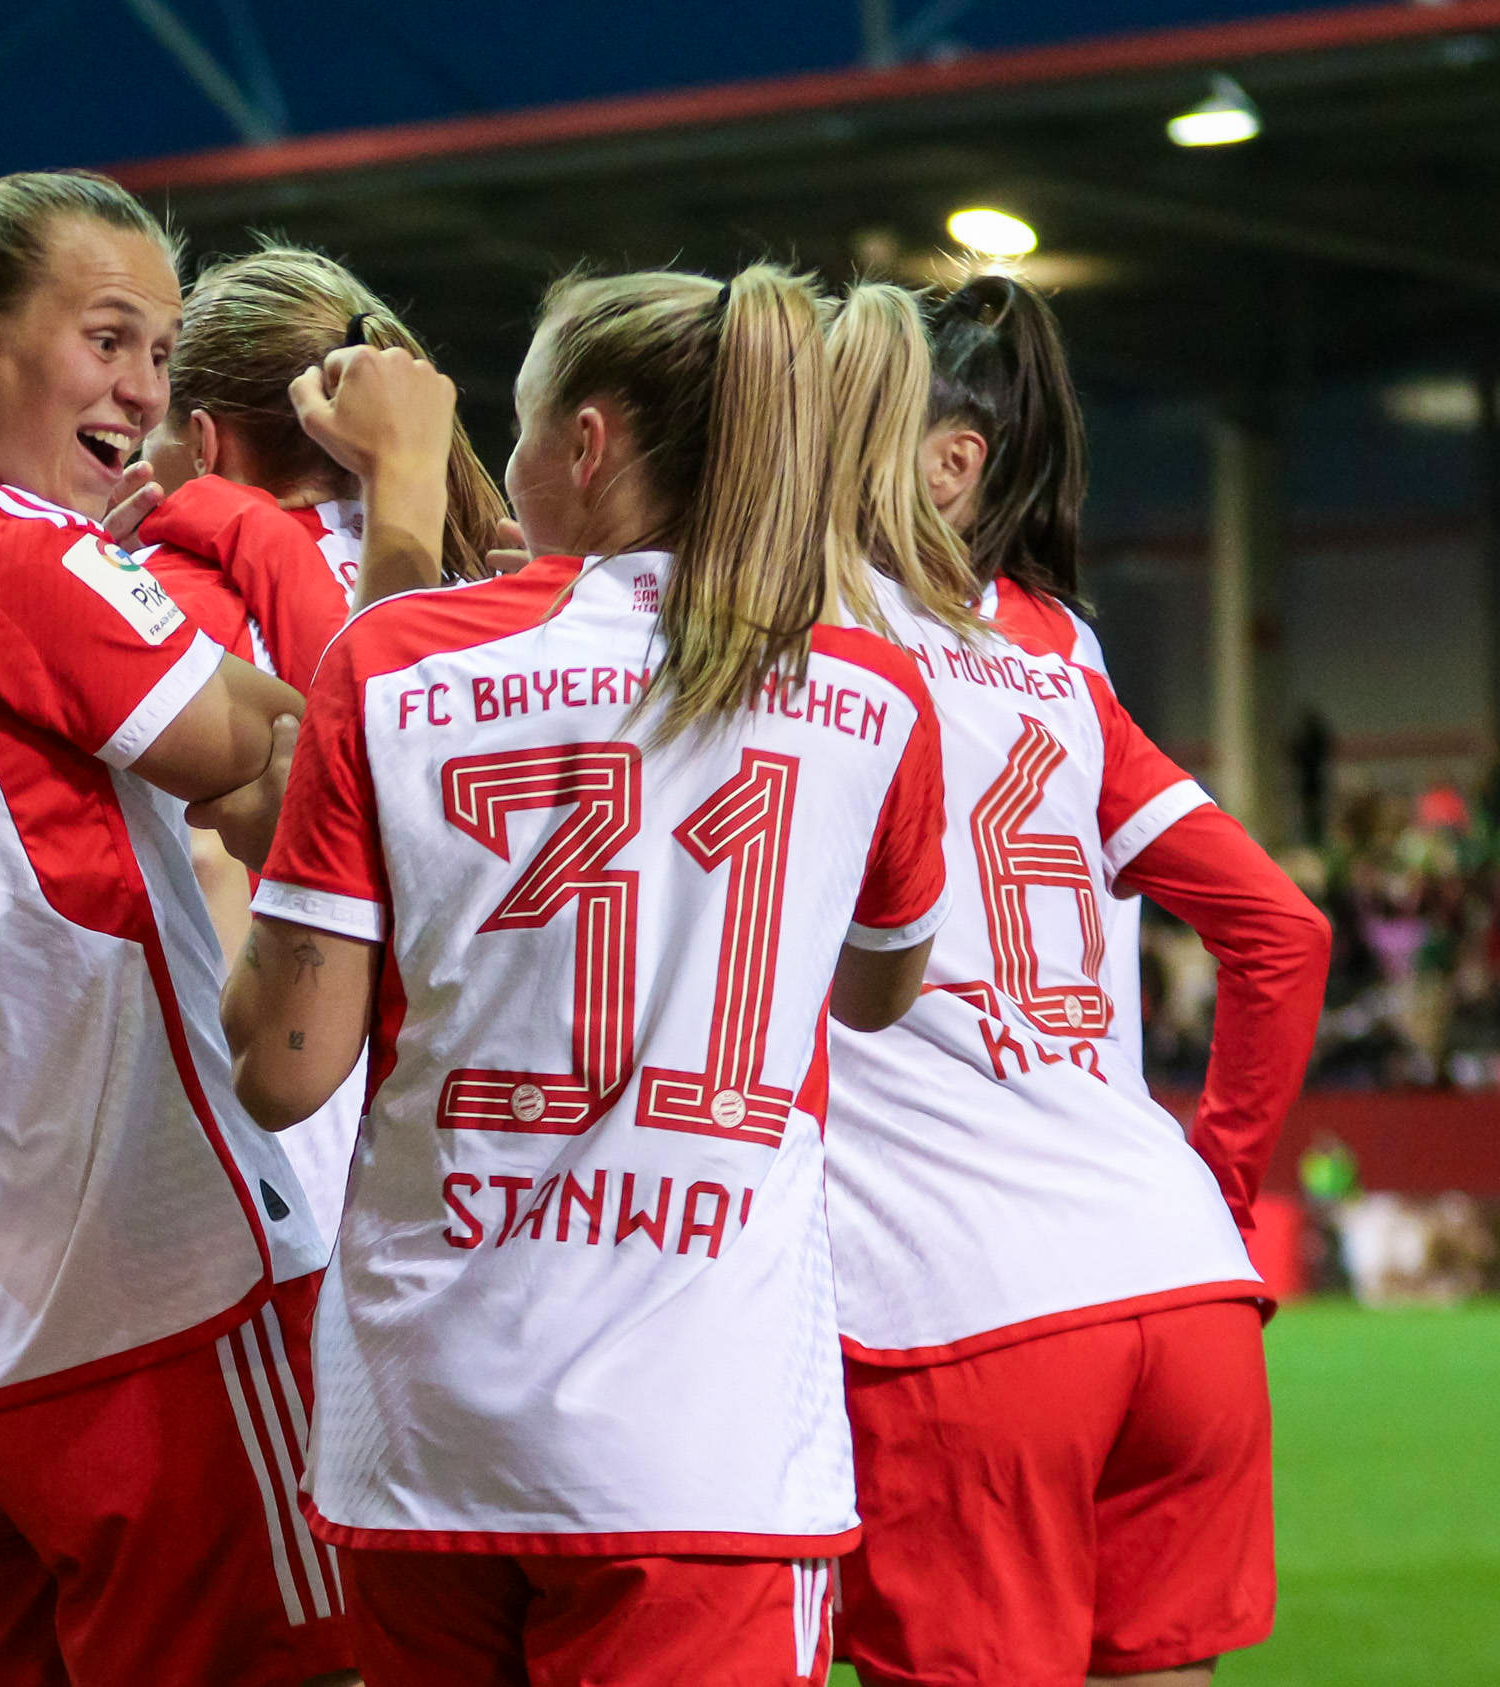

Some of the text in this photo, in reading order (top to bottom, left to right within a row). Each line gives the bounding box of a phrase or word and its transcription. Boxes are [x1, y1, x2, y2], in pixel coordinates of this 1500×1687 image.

[398, 683, 452, 730] FC
[472, 667, 650, 723] BAYERN
[940, 643, 1077, 701] MÜNCHEN
[437, 742, 801, 1149] 31
